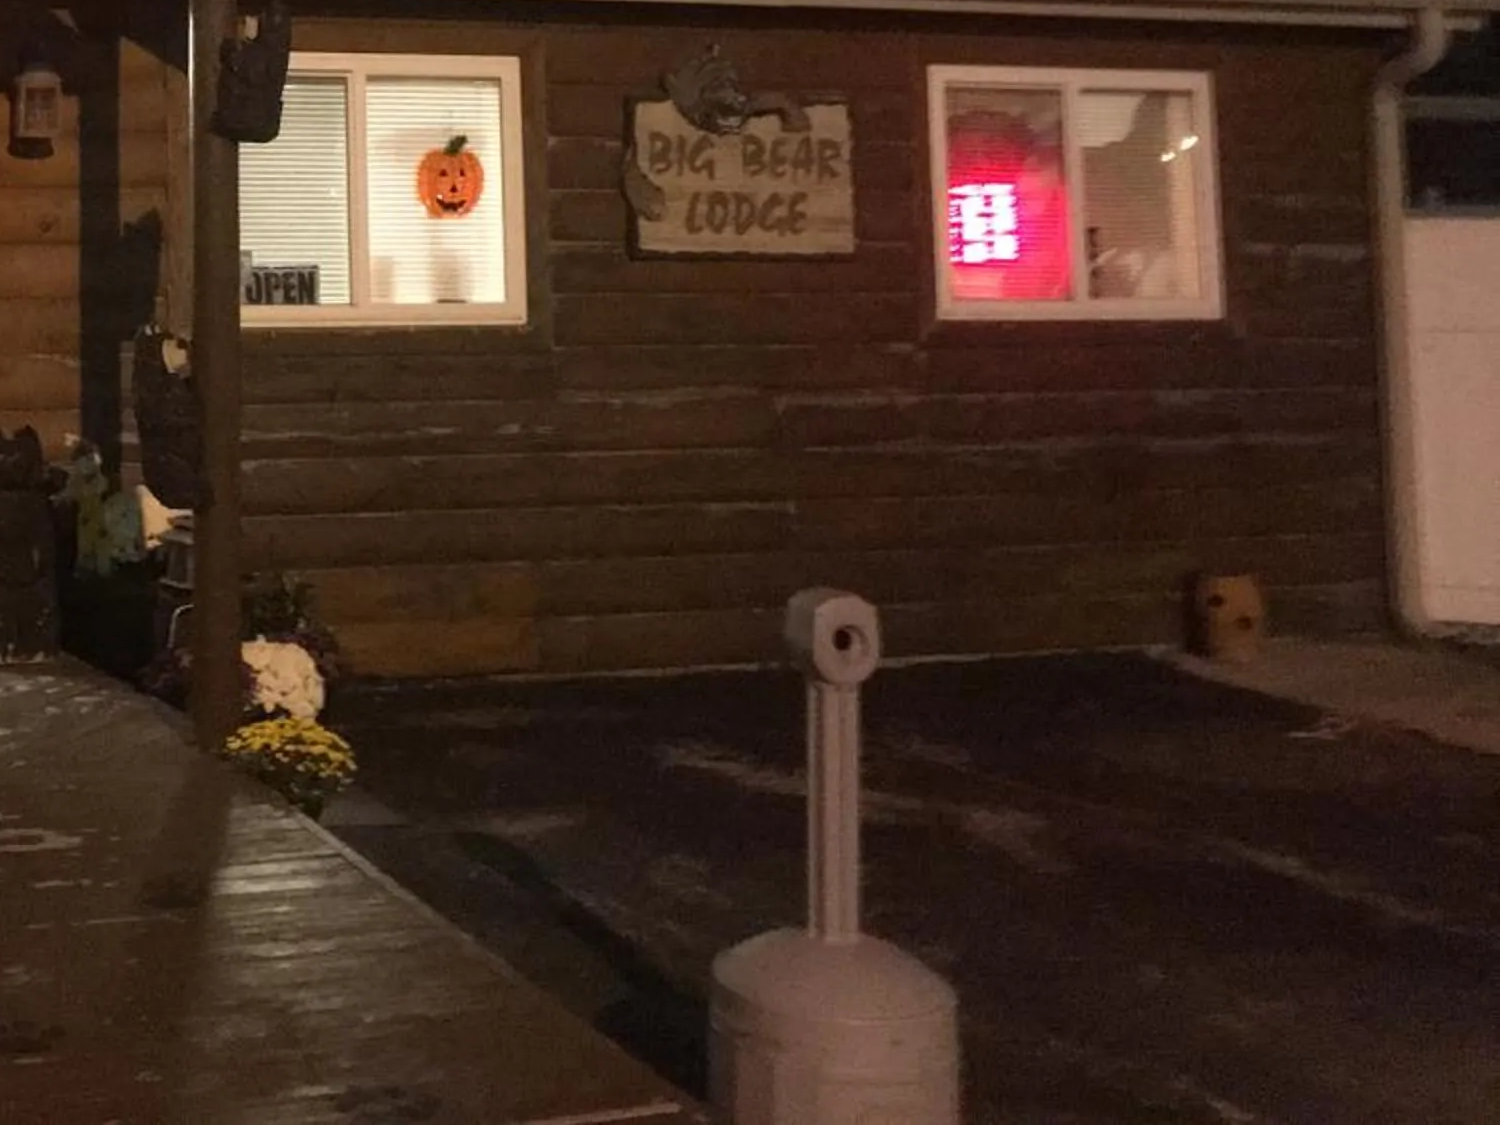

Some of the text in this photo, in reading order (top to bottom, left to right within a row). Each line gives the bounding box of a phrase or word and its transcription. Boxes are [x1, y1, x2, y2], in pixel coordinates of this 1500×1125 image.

[647, 130, 842, 183] BIG BEAR
[683, 189, 809, 237] LODGE
[244, 270, 317, 305] OPEN
